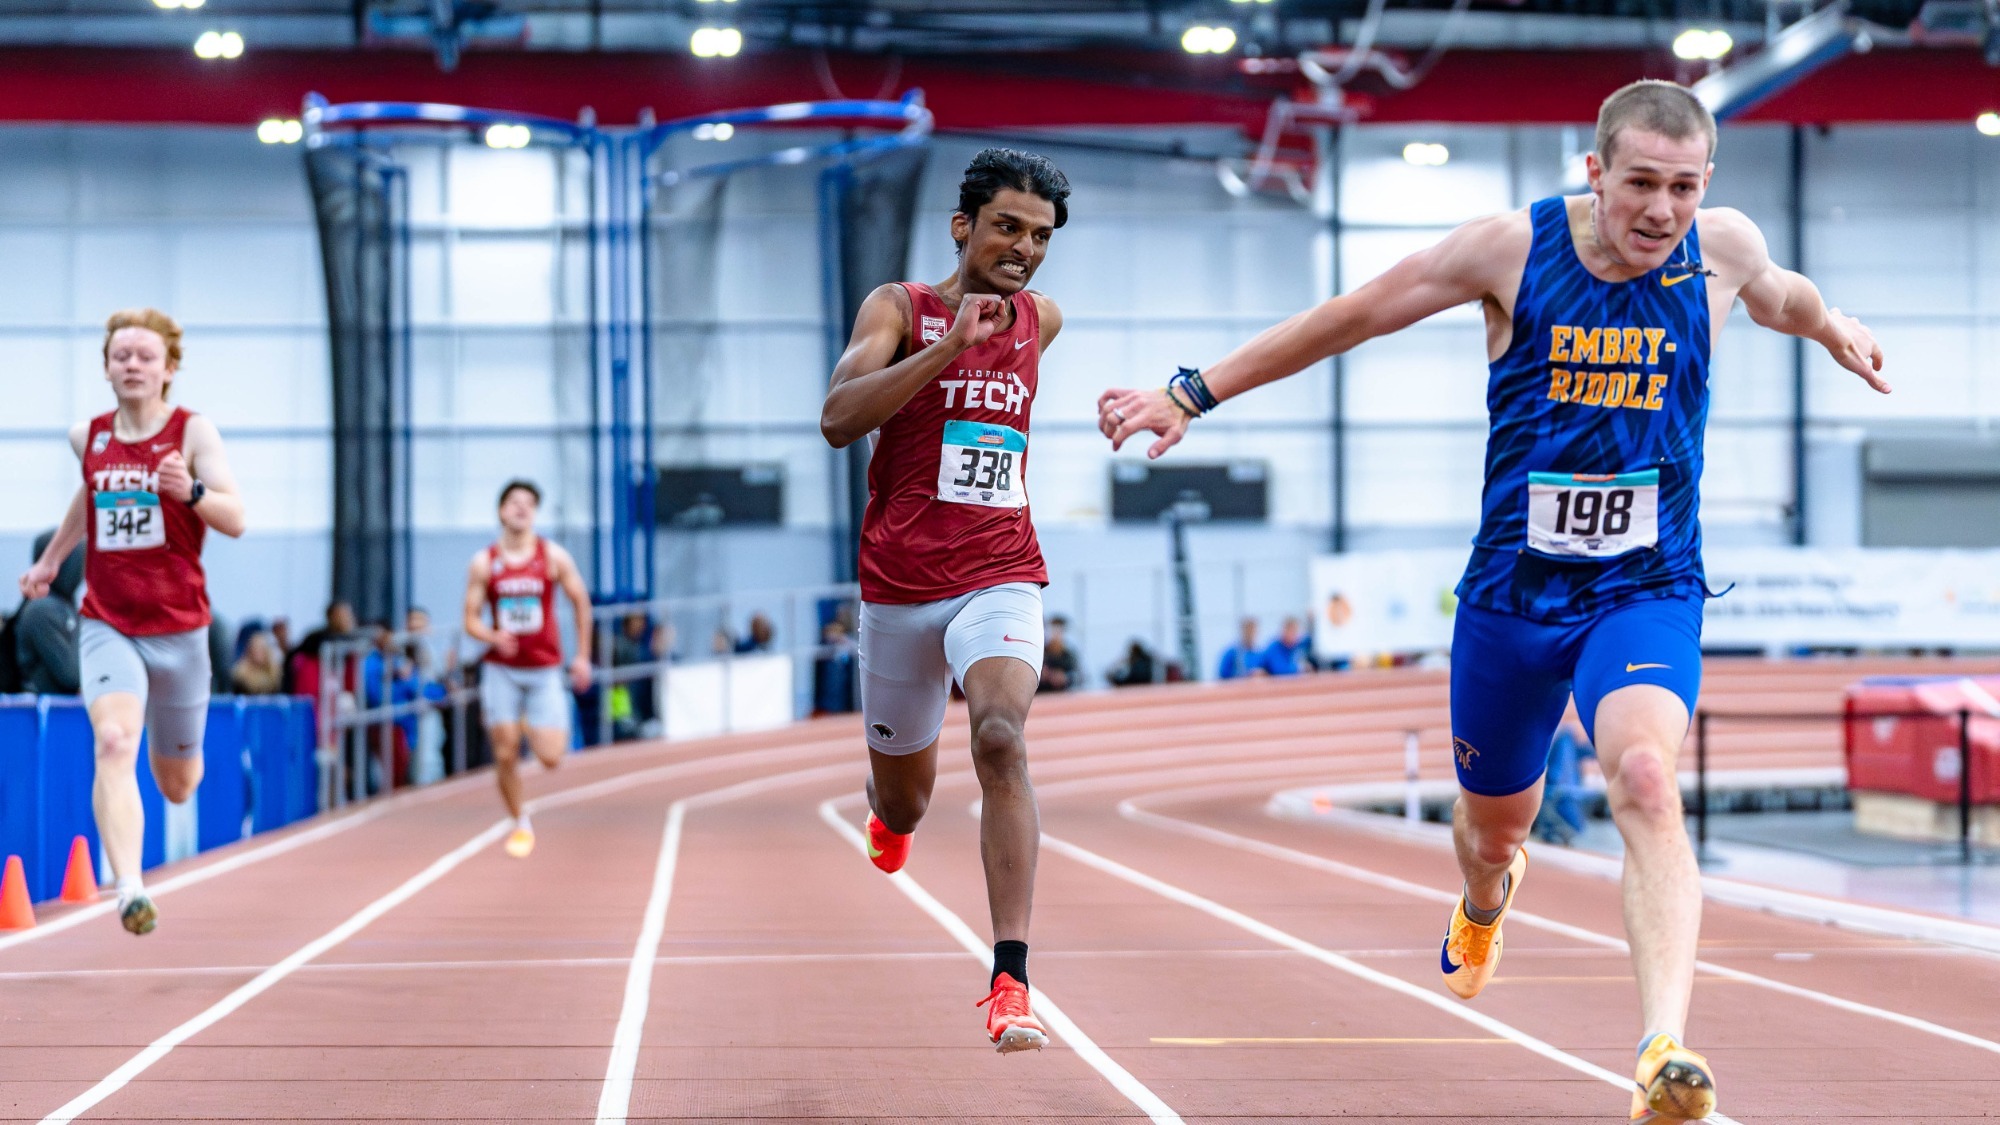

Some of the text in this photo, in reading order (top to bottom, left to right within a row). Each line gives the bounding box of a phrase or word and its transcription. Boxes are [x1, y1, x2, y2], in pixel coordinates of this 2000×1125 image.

[1548, 324, 1677, 365] EMBRY-
[939, 373, 1030, 415] TECH
[958, 369, 1013, 380] FLORIDA
[1546, 368, 1668, 411] RIDDLE
[93, 469, 160, 493] TECH
[953, 448, 1013, 491] 338
[105, 508, 152, 537] 342
[1554, 489, 1634, 536] 198
